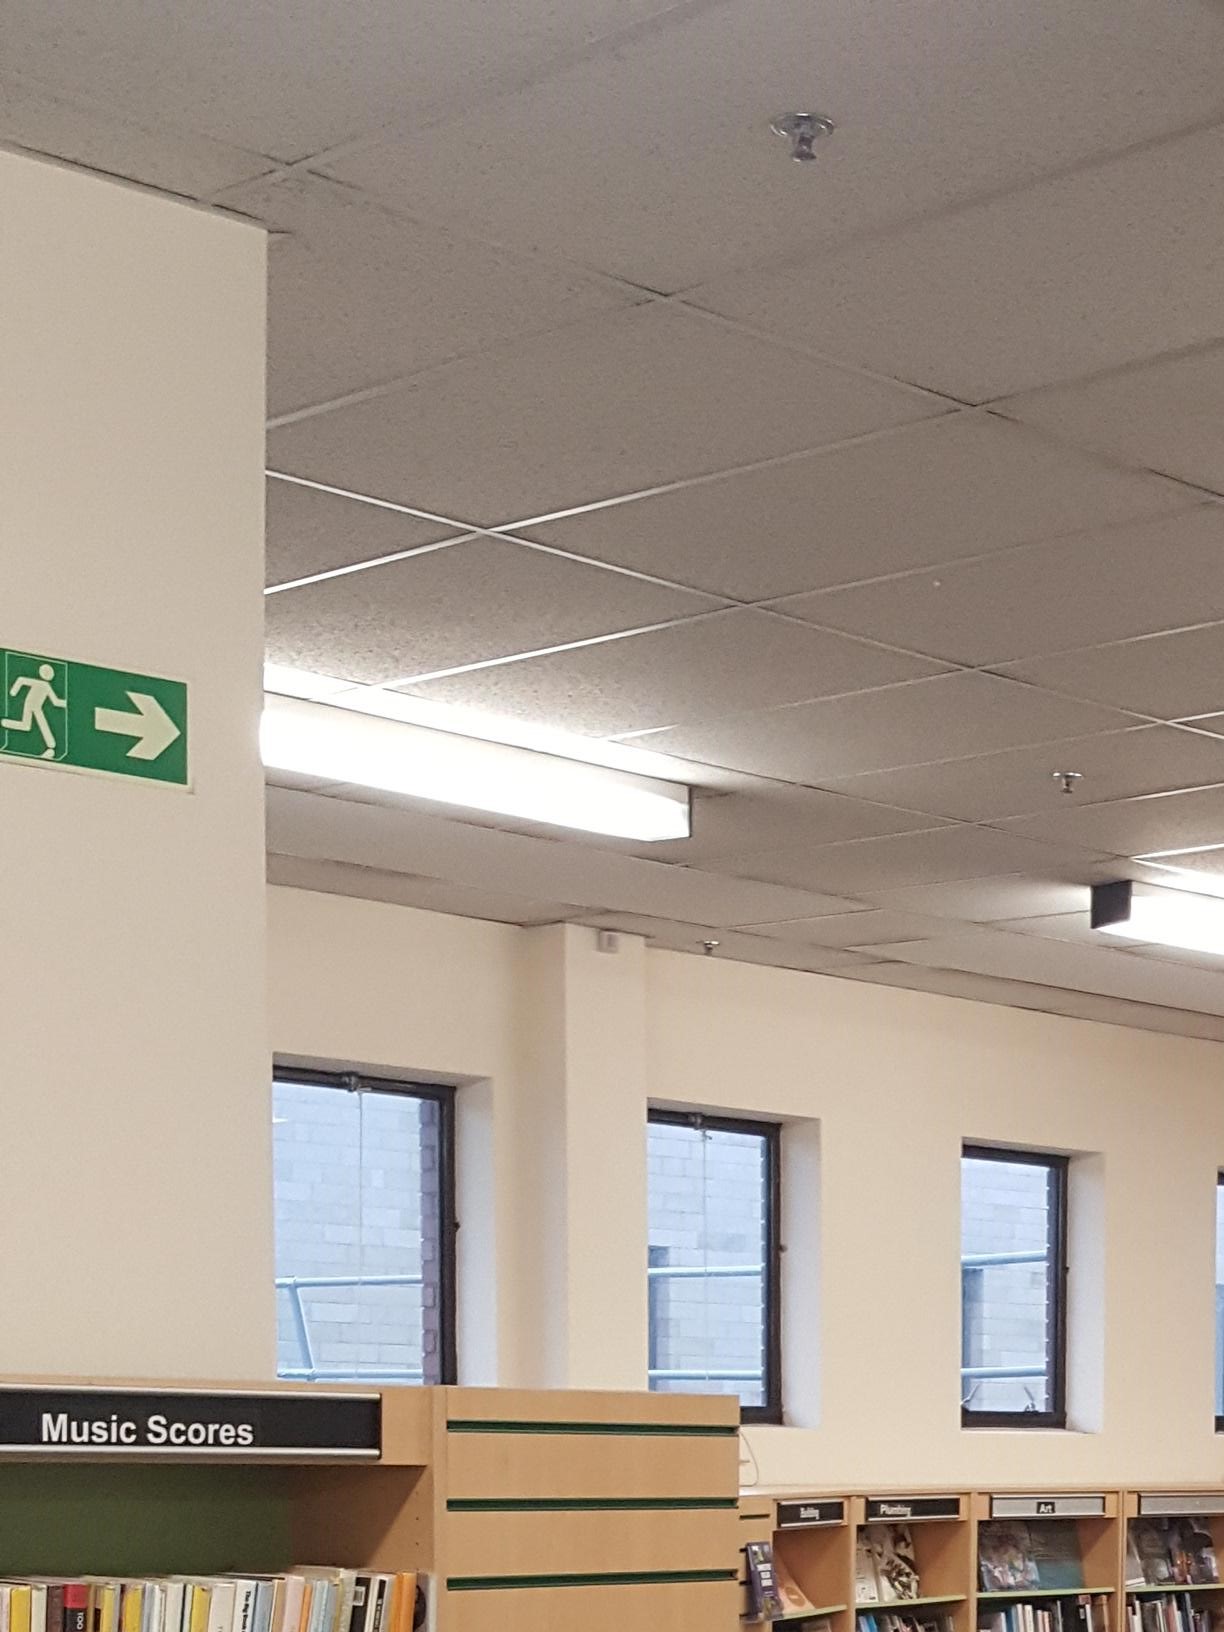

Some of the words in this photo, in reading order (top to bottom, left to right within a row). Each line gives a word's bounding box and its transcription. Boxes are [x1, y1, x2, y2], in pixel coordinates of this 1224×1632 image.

[42, 1413, 137, 1443] Music
[147, 1415, 254, 1446] Scores
[880, 1504, 911, 1517] Plumbing
[1040, 1503, 1053, 1513] Art
[76, 1612, 84, 1630] 100
